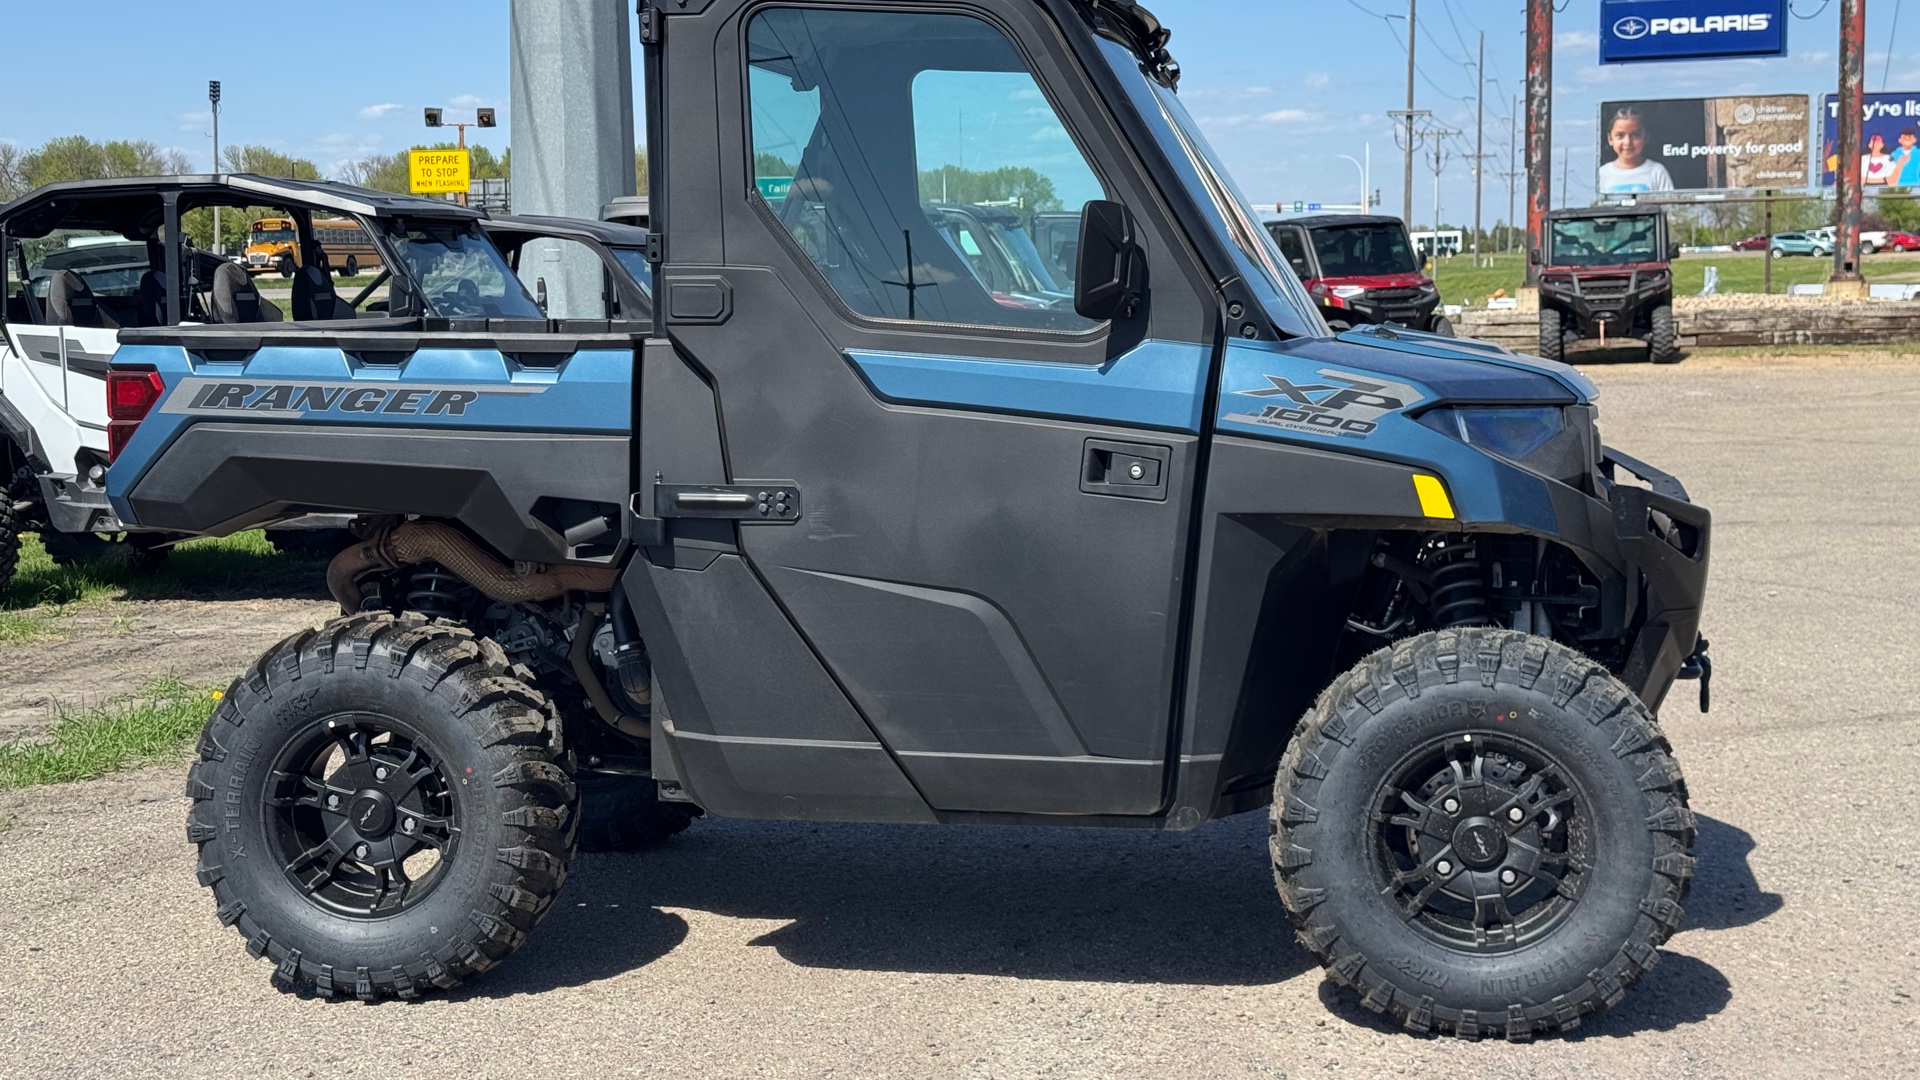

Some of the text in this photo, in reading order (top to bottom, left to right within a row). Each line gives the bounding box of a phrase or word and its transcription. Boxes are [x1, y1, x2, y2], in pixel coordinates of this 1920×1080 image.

[1650, 14, 1769, 35] POLARIS
[1756, 105, 1786, 114] children
[1828, 100, 1902, 121] Ty're
[1663, 139, 1802, 158] End poverty for good
[418, 155, 460, 165] PREPARE
[421, 168, 458, 177] TO STOP
[1756, 170, 1802, 179] children.org
[436, 179, 465, 187] FLASHING
[190, 383, 479, 416] RANGER
[1232, 373, 1406, 411] XP
[1256, 418, 1283, 428] DUAL
[1285, 423, 1342, 437] OVERHEAD
[1260, 405, 1378, 434] 1000
[225, 735, 263, 862] X-TERRAIN
